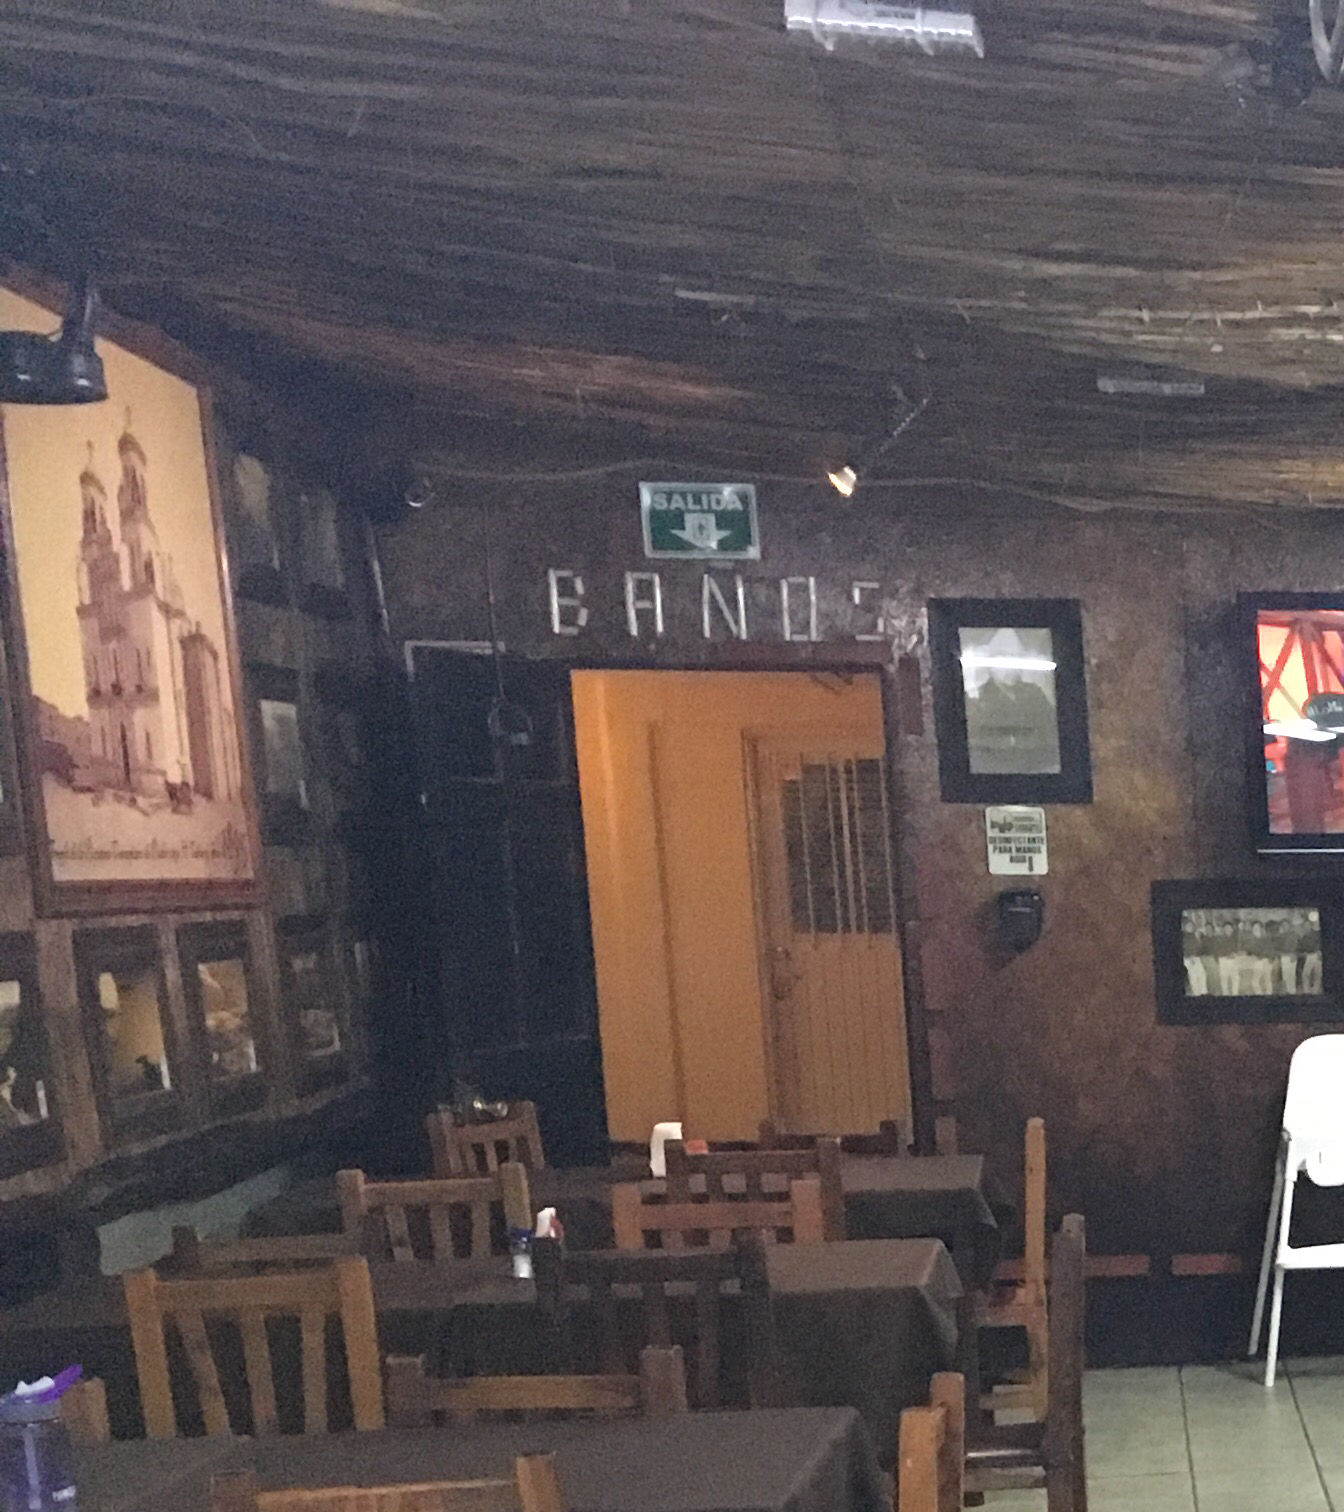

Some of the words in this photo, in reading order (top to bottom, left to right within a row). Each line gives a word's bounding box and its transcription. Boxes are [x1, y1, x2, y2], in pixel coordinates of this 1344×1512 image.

[652, 493, 743, 511] SALIDA
[992, 846, 1013, 854] PARA
[1015, 846, 1042, 854] MANOS
